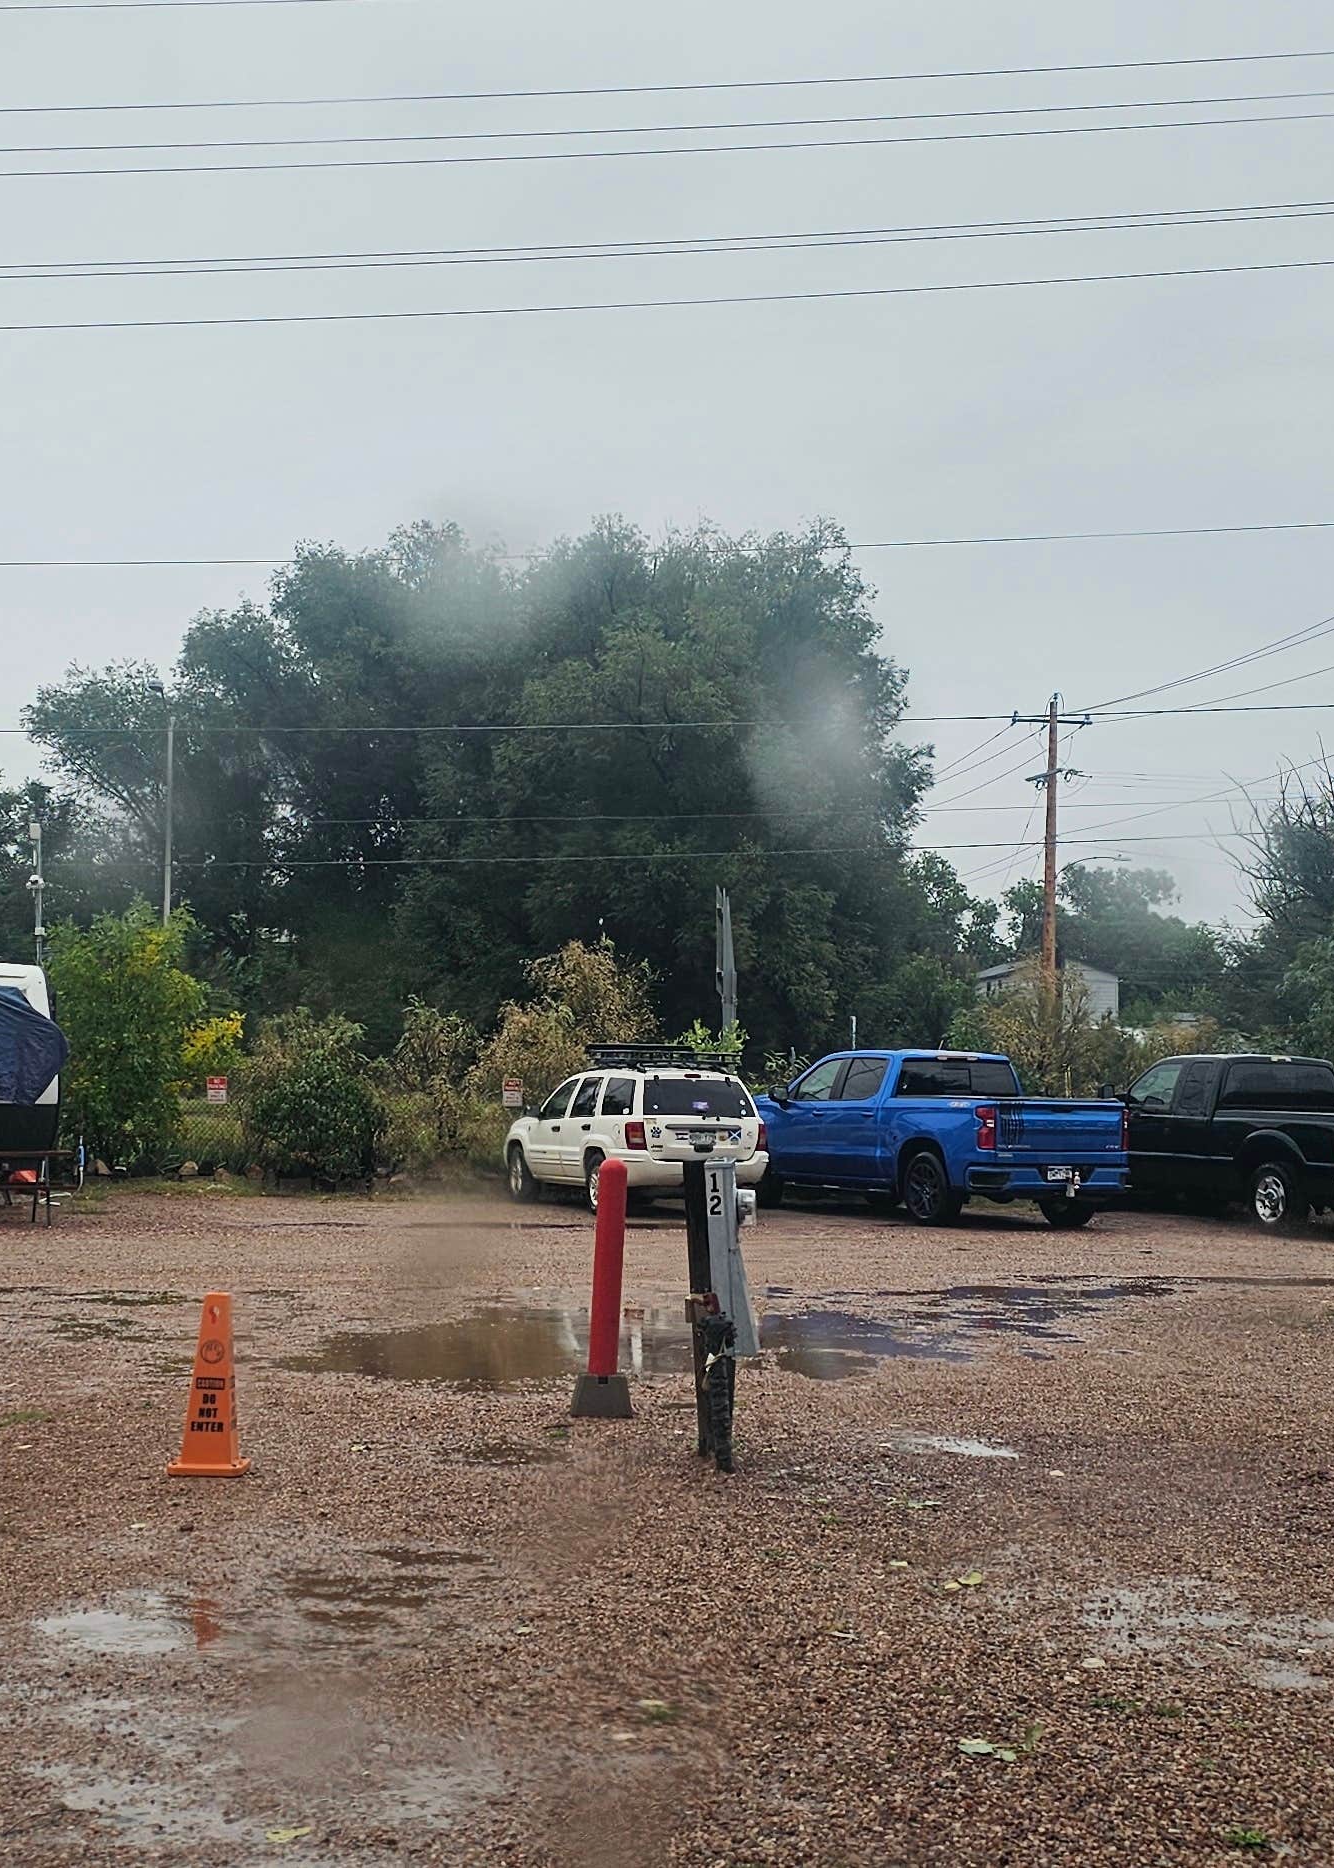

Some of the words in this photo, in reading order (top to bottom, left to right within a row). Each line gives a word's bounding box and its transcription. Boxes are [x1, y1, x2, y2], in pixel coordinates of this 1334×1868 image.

[202, 1393, 217, 1405] DO
[198, 1407, 219, 1419] NOT
[190, 1421, 225, 1433] ENTER
